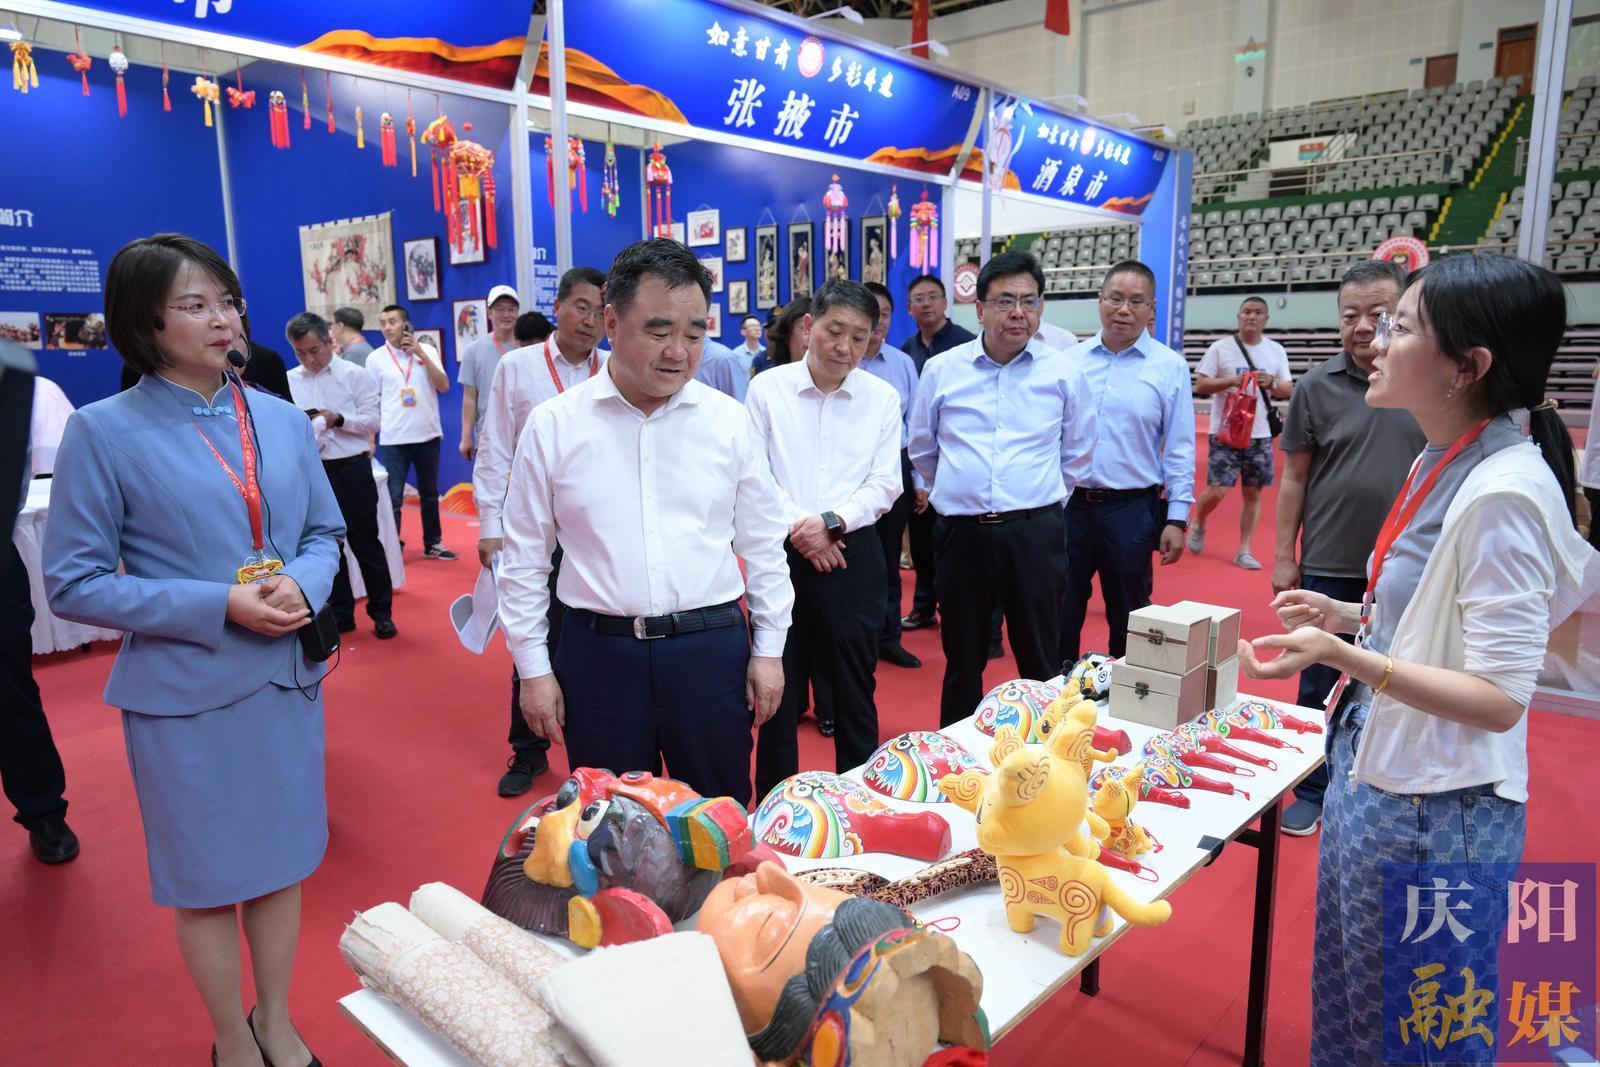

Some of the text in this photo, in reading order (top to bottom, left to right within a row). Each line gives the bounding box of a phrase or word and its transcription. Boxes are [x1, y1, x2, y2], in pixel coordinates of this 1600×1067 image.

[706, 21, 791, 71] 如意甘肃
[723, 78, 860, 148] 张掖市
[952, 84, 971, 101] A09
[1032, 157, 1108, 201] 酒泉市
